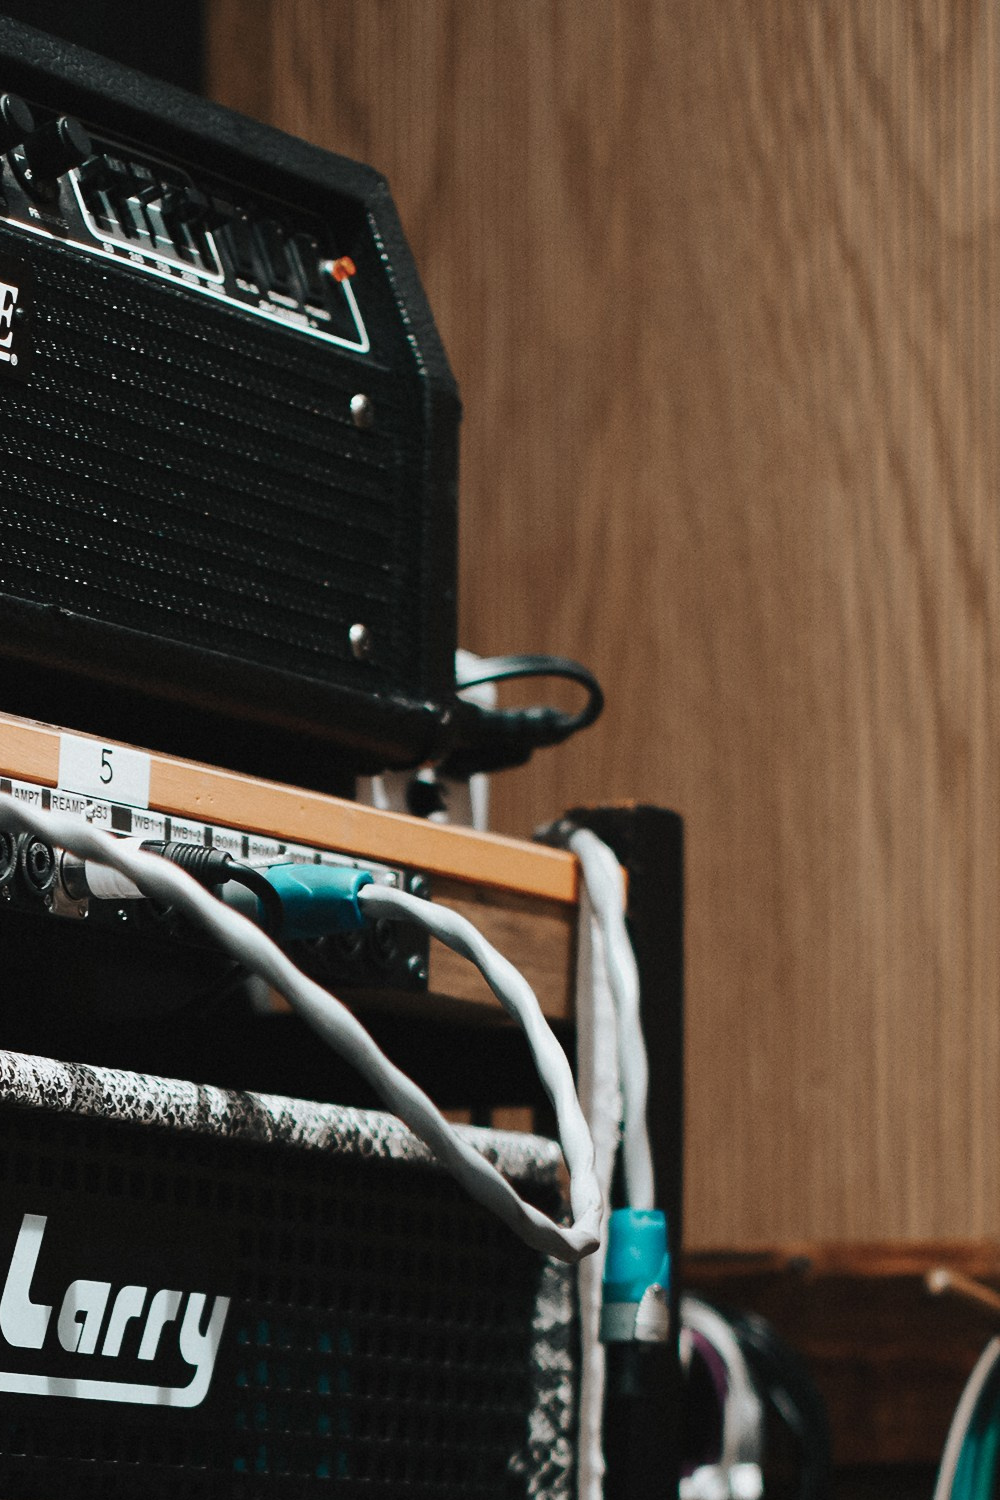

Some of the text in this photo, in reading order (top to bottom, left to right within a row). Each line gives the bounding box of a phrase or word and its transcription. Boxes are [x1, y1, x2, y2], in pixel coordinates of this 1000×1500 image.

[99, 748, 113, 784] 5
[14, 788, 40, 805] AMP7
[52, 795, 85, 813] REAMP
